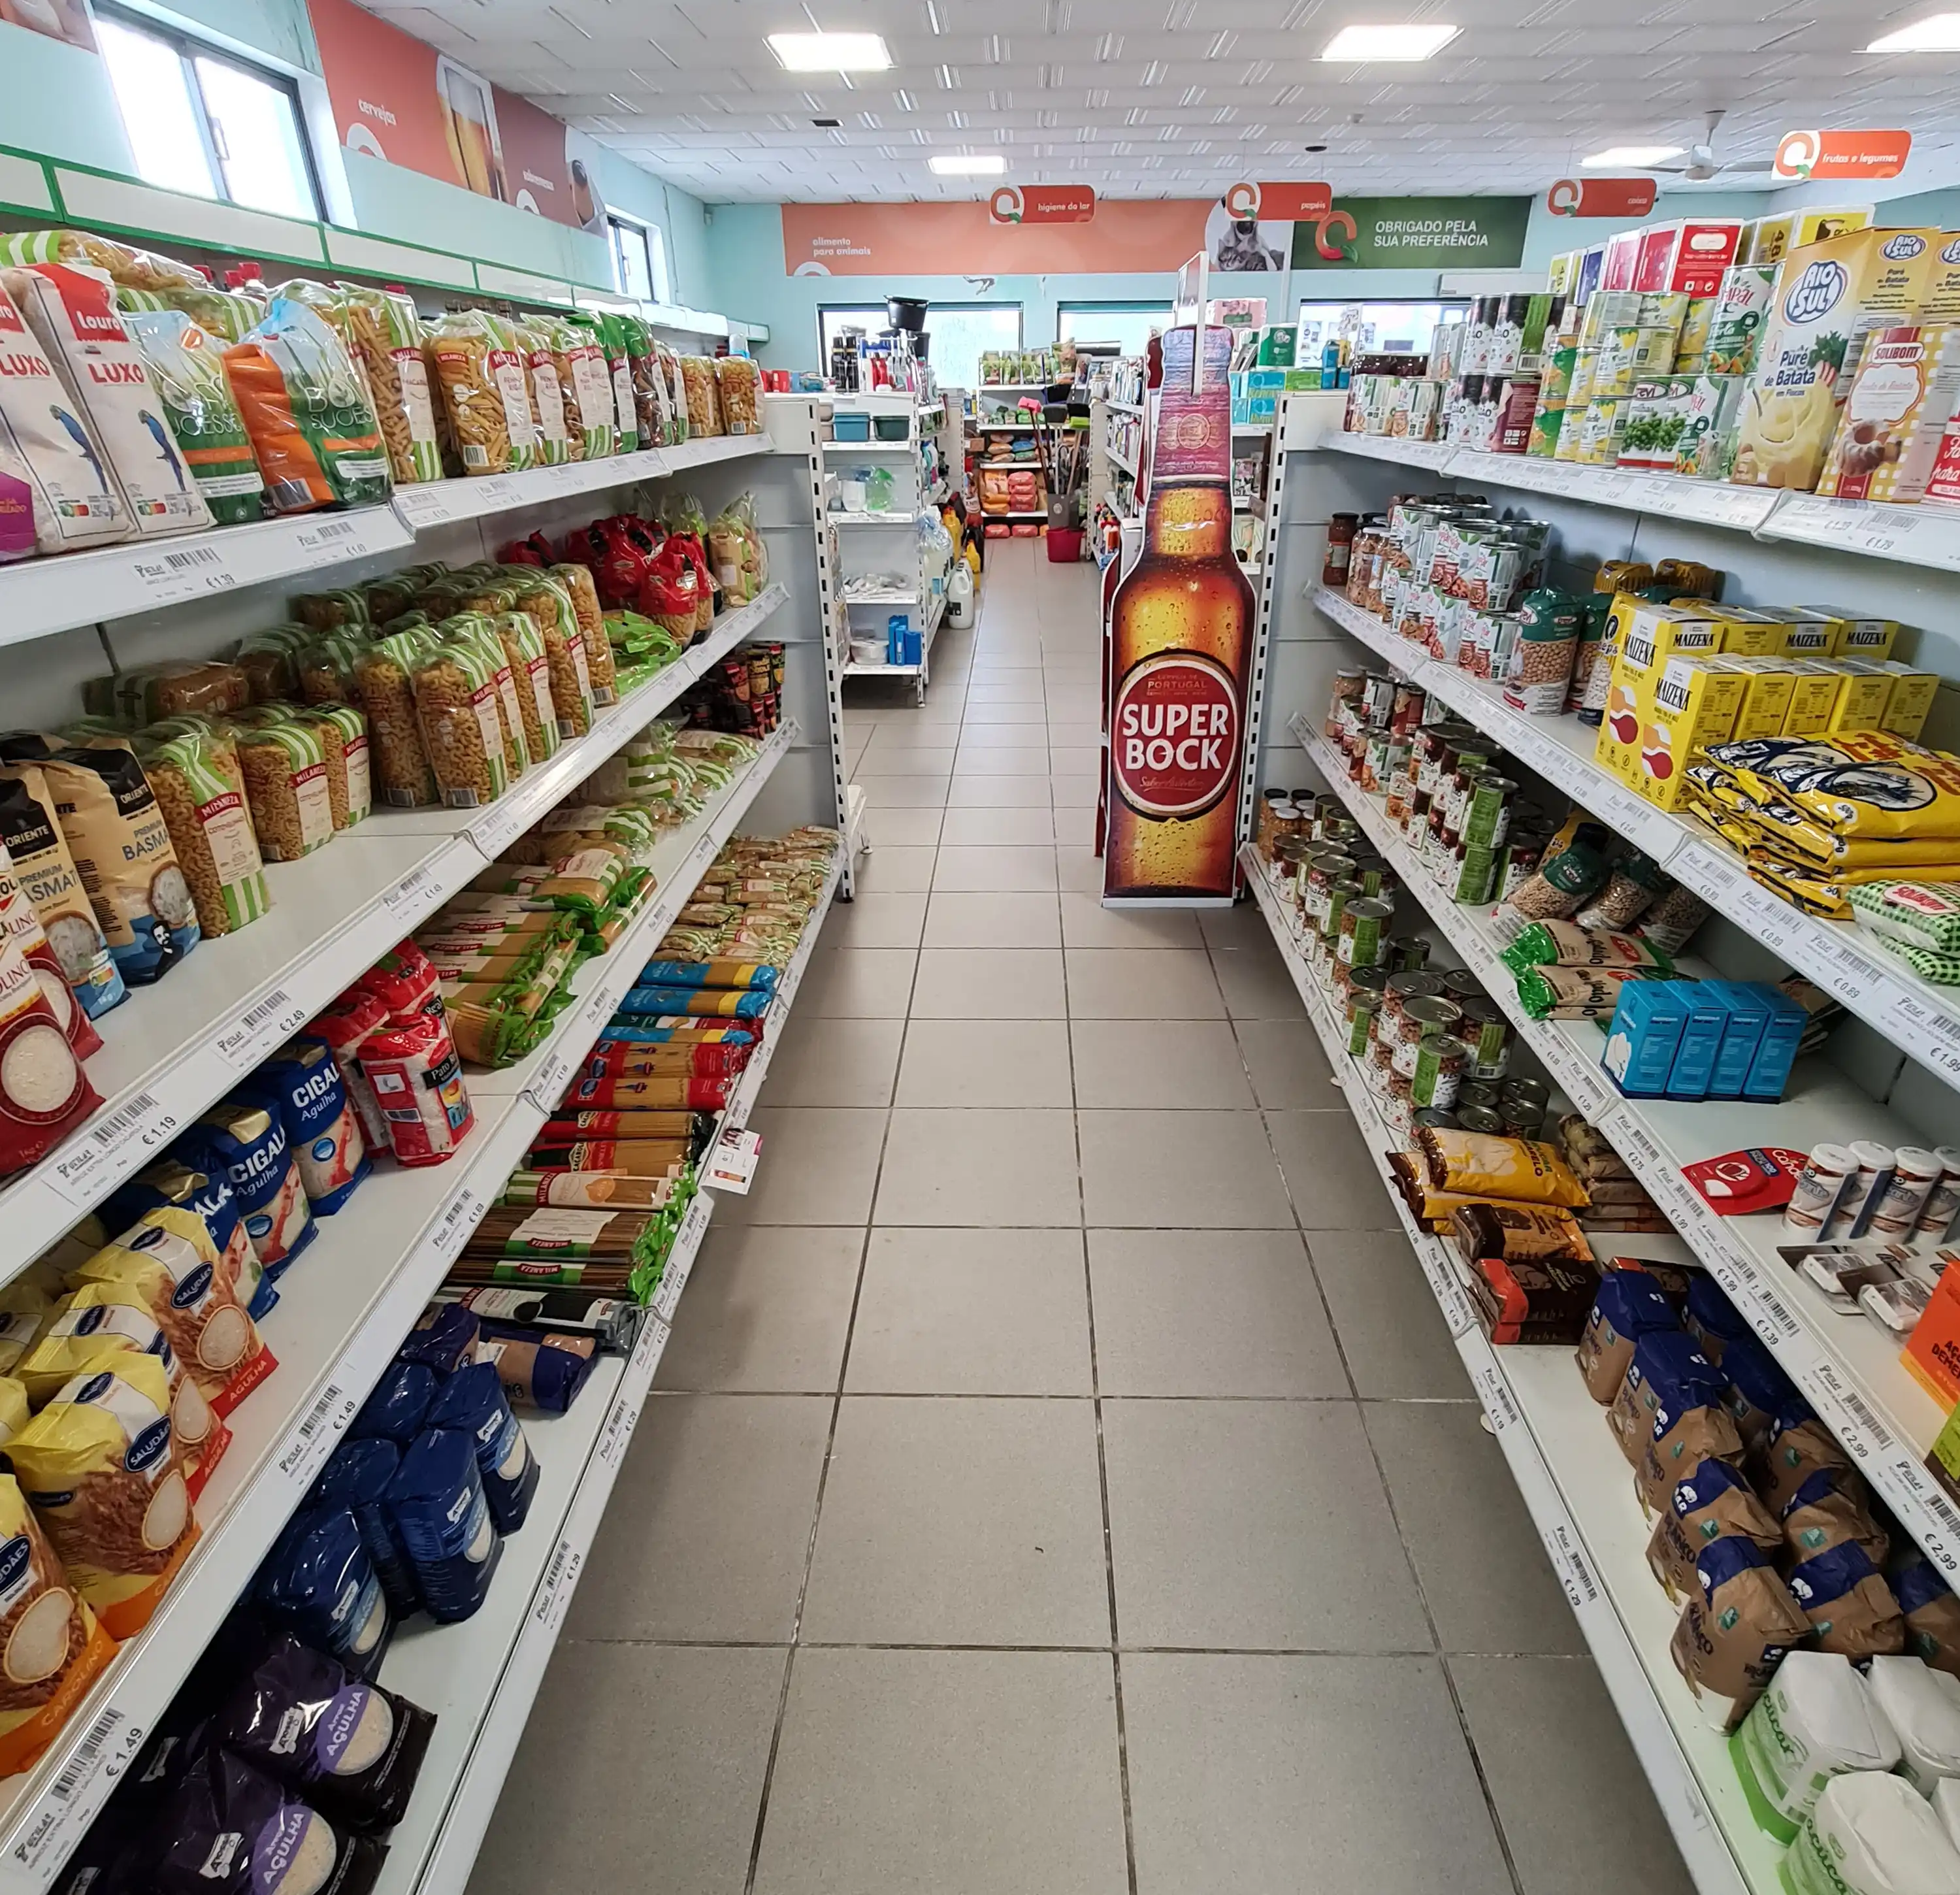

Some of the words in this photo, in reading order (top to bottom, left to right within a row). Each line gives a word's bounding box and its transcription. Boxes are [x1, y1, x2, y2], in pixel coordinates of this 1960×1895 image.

[359, 99, 397, 125] cervejas
[1822, 154, 1848, 163] frutas
[1859, 153, 1899, 165] legumes
[1037, 203, 1066, 212] higiene
[1375, 220, 1443, 233] OBRIGADO
[1445, 220, 1477, 233] PELA
[812, 237, 851, 246] alimento
[1374, 235, 1399, 247] SUA
[1401, 232, 1489, 247] PREFERÊNCIA
[813, 248, 834, 257] para
[836, 247, 871, 256] animais
[1803, 261, 1837, 288] RIO
[1793, 288, 1829, 316] SUL
[0, 354, 50, 376] LUXO
[1780, 348, 1807, 367] Puré
[88, 363, 145, 384] LUXO
[1764, 376, 1773, 387] de
[1776, 369, 1815, 386] Batata
[1673, 634, 1715, 647] MAIZENA
[1786, 634, 1829, 647] MAIZENA
[1846, 632, 1889, 645] MAIZENA
[1622, 633, 1658, 667] MAIZENA
[1653, 677, 1693, 712] MAIZENA
[1122, 703, 1229, 736] SUPER
[1125, 738, 1222, 771] BOCK
[120, 784, 149, 804] ORIENTE
[5, 825, 49, 848] ORIENTE
[134, 819, 163, 838] PREMIUM
[19, 863, 63, 885] PREMIUM
[280, 1023, 289, 1032] €
[287, 1010, 306, 1028] 2.49
[1930, 1047, 1941, 1059] €
[431, 1062, 450, 1081] Pato
[301, 1091, 337, 1121] Agulha
[142, 1134, 155, 1145] €
[152, 1116, 176, 1137] 1.19
[236, 1164, 279, 1197] Agulha
[230, 1360, 267, 1402] AGULHA
[333, 1421, 342, 1430] €
[338, 1400, 356, 1421] 1.49
[1840, 1426, 1852, 1436] €
[1925, 1533, 1936, 1544] €
[570, 1553, 580, 1572] 1.29
[41, 1640, 102, 1726] CAROLINO
[327, 1691, 363, 1756] AGULHA
[106, 1765, 120, 1777] €
[116, 1728, 143, 1761] 1.49
[263, 1813, 304, 1885] AGULHA
